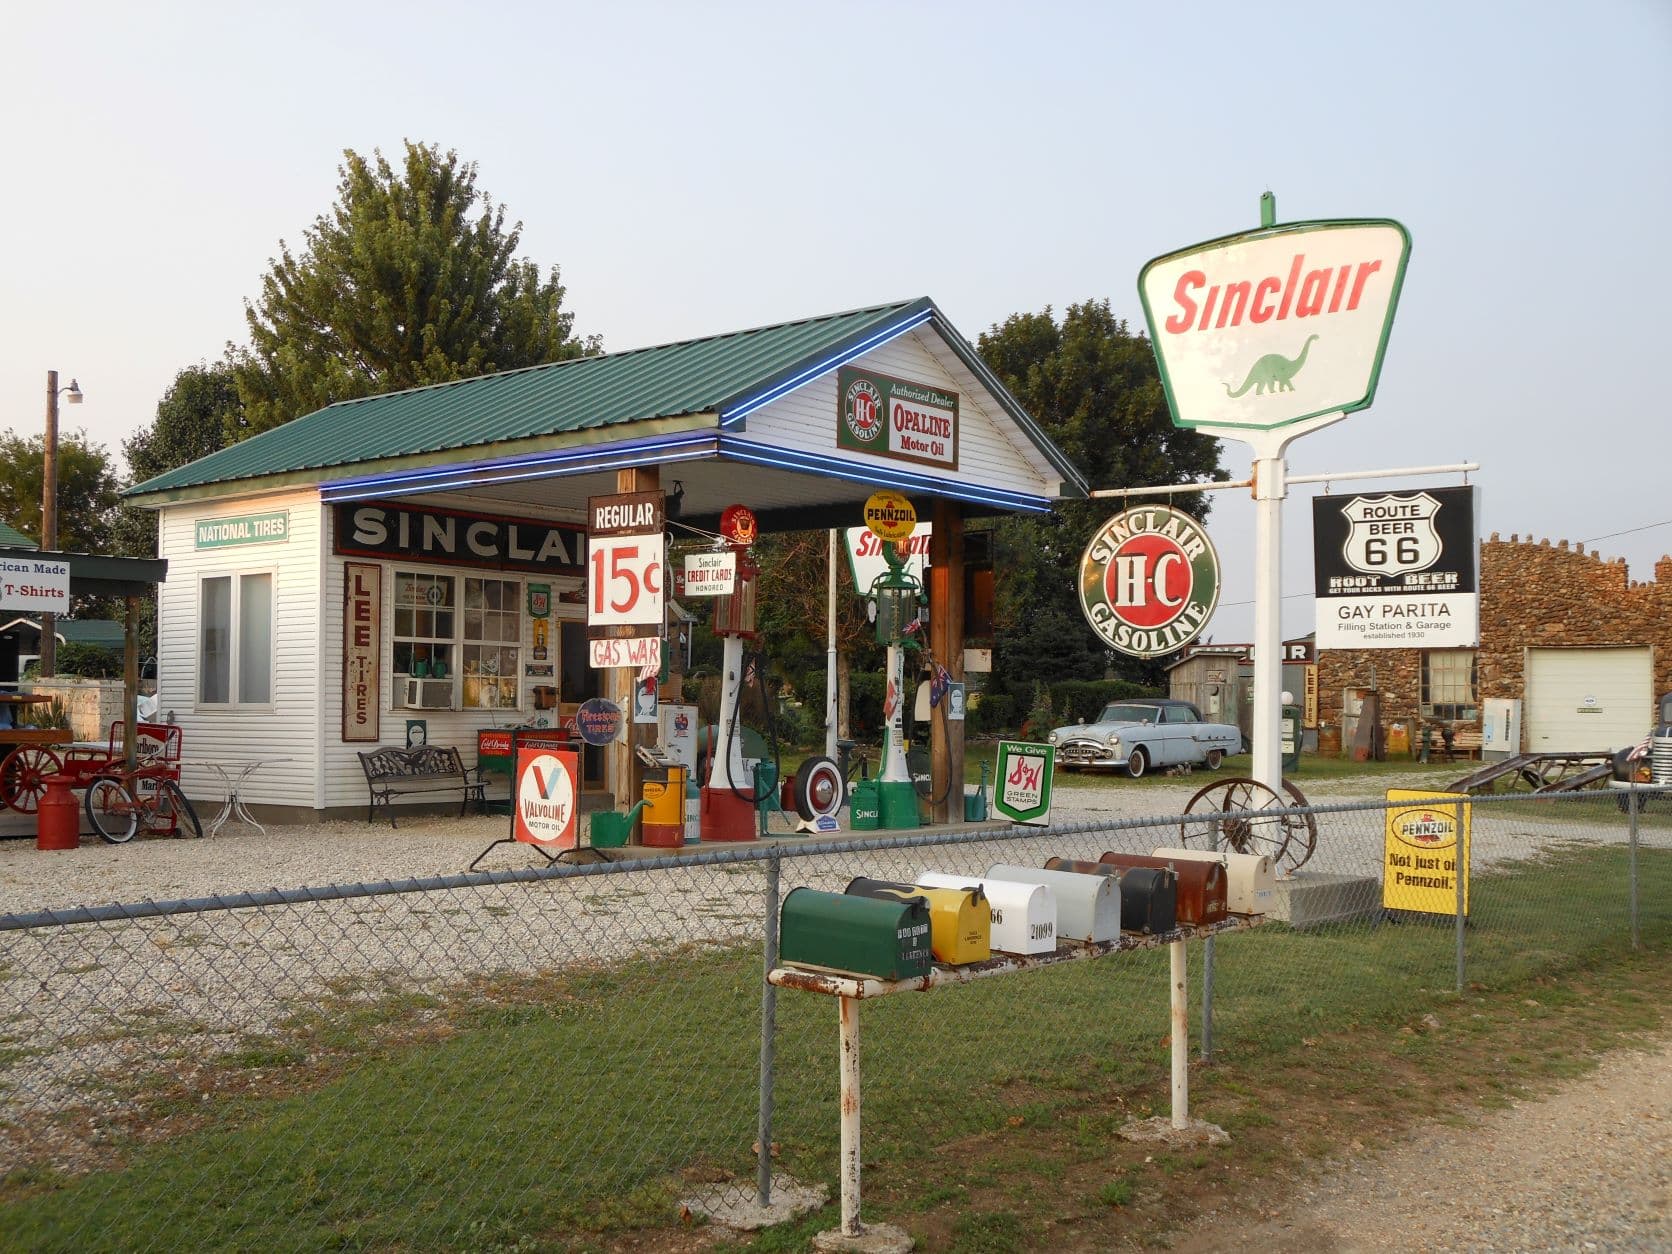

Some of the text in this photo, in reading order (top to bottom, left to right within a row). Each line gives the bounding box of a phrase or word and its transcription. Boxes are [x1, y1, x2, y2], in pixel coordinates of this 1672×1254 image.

[1165, 254, 1382, 335] Sinclair
[848, 381, 881, 409] SINCLAIR
[890, 384, 954, 408] Authorized Dealer
[847, 412, 882, 439] GASOLINE
[894, 403, 951, 439] OPALINE
[900, 435, 944, 456] Motor Oil
[596, 502, 654, 529] REGULAR
[868, 508, 914, 522] PENNZOIL
[1363, 504, 1420, 519] ROUTE
[199, 518, 284, 542] NATIONAL TIRES
[352, 508, 584, 566] SINCLAI
[1369, 522, 1415, 536] BEER
[1091, 512, 1206, 566] SINCLAIR
[1365, 536, 1420, 566] 66
[34, 564, 66, 575] Made
[698, 557, 722, 568] Sinclair
[688, 569, 710, 583] CREDIT
[712, 568, 732, 582] CARDS
[1330, 572, 1458, 588] ROOT BEER
[5, 584, 64, 598] T-Shirts
[696, 584, 723, 592] HONORED
[354, 574, 370, 647] LEE
[1338, 602, 1451, 620] GAY PARITA
[1090, 601, 1208, 651] GASOLINE
[1338, 621, 1452, 632] Filling Station & Garage
[1364, 632, 1406, 640] established
[594, 638, 659, 666] GAS WAR
[356, 656, 368, 724] TIRES
[137, 738, 159, 754] arlboro
[1007, 744, 1047, 754] We Give
[1008, 756, 1042, 791] S&H
[1006, 790, 1037, 798] GREEN
[1006, 796, 1037, 804] STAMPS
[524, 798, 566, 824] VALVOLINE
[529, 821, 550, 829] MOTOR
[1402, 822, 1454, 835] PENNZOIL
[1390, 853, 1457, 871] Not just oi
[1397, 872, 1453, 889] Pennzoil.
[991, 908, 1003, 924] 66
